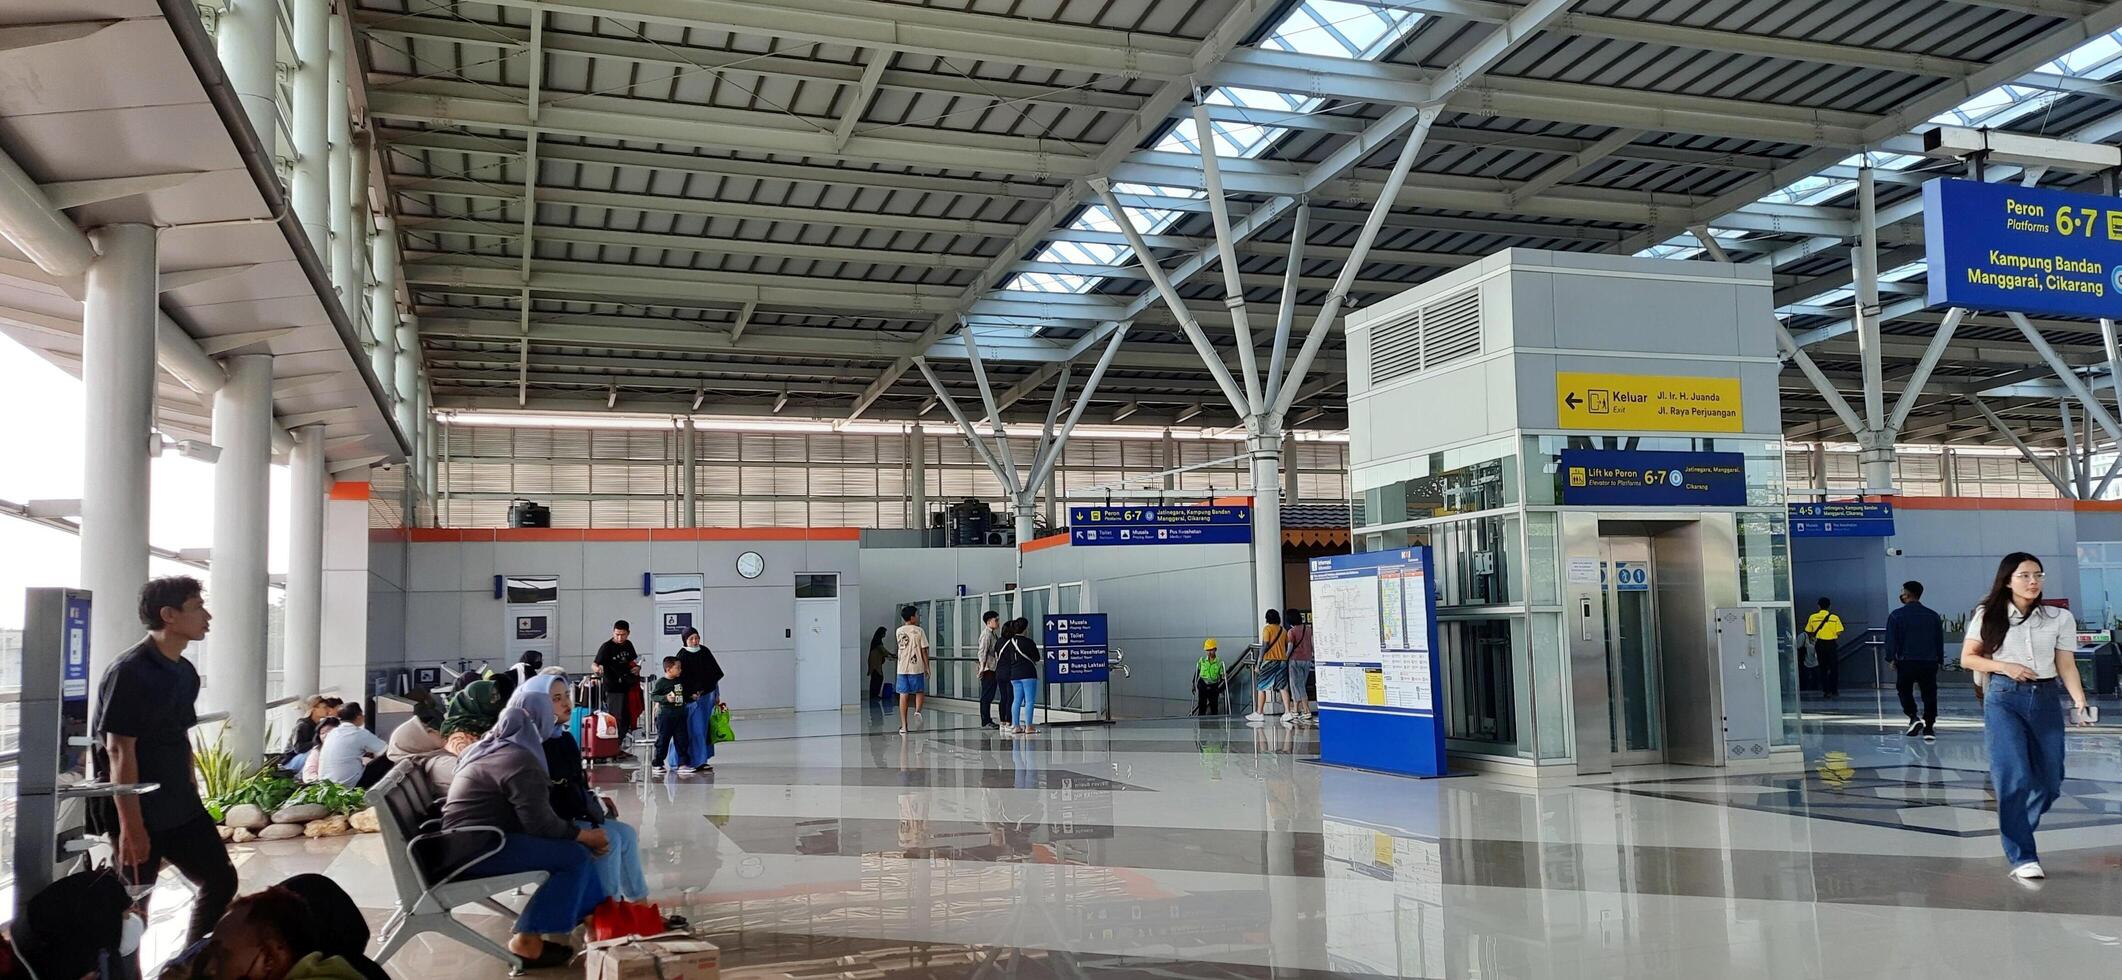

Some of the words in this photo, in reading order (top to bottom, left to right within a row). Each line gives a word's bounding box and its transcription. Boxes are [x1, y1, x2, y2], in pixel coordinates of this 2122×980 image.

[2007, 199, 2043, 217] Peron
[2007, 218, 2049, 233] Platforms
[1990, 250, 2052, 273] Kampung
[2056, 256, 2102, 274] Bandan
[1968, 268, 2043, 291] Manggarai,
[2046, 276, 2104, 297] Cikarang
[1613, 392, 1648, 403] Keluar
[1657, 392, 1666, 400] Jl.
[1669, 392, 1678, 400] Ir.
[1680, 392, 1689, 400] H.
[1691, 393, 1720, 402] Juanda
[1658, 406, 1668, 414] Jl.
[1670, 407, 1690, 418] Raya
[1692, 408, 1736, 418] Perjuangan
[1588, 468, 1602, 477] Lift
[1604, 468, 1614, 477] ke
[1615, 469, 1638, 478] Peron
